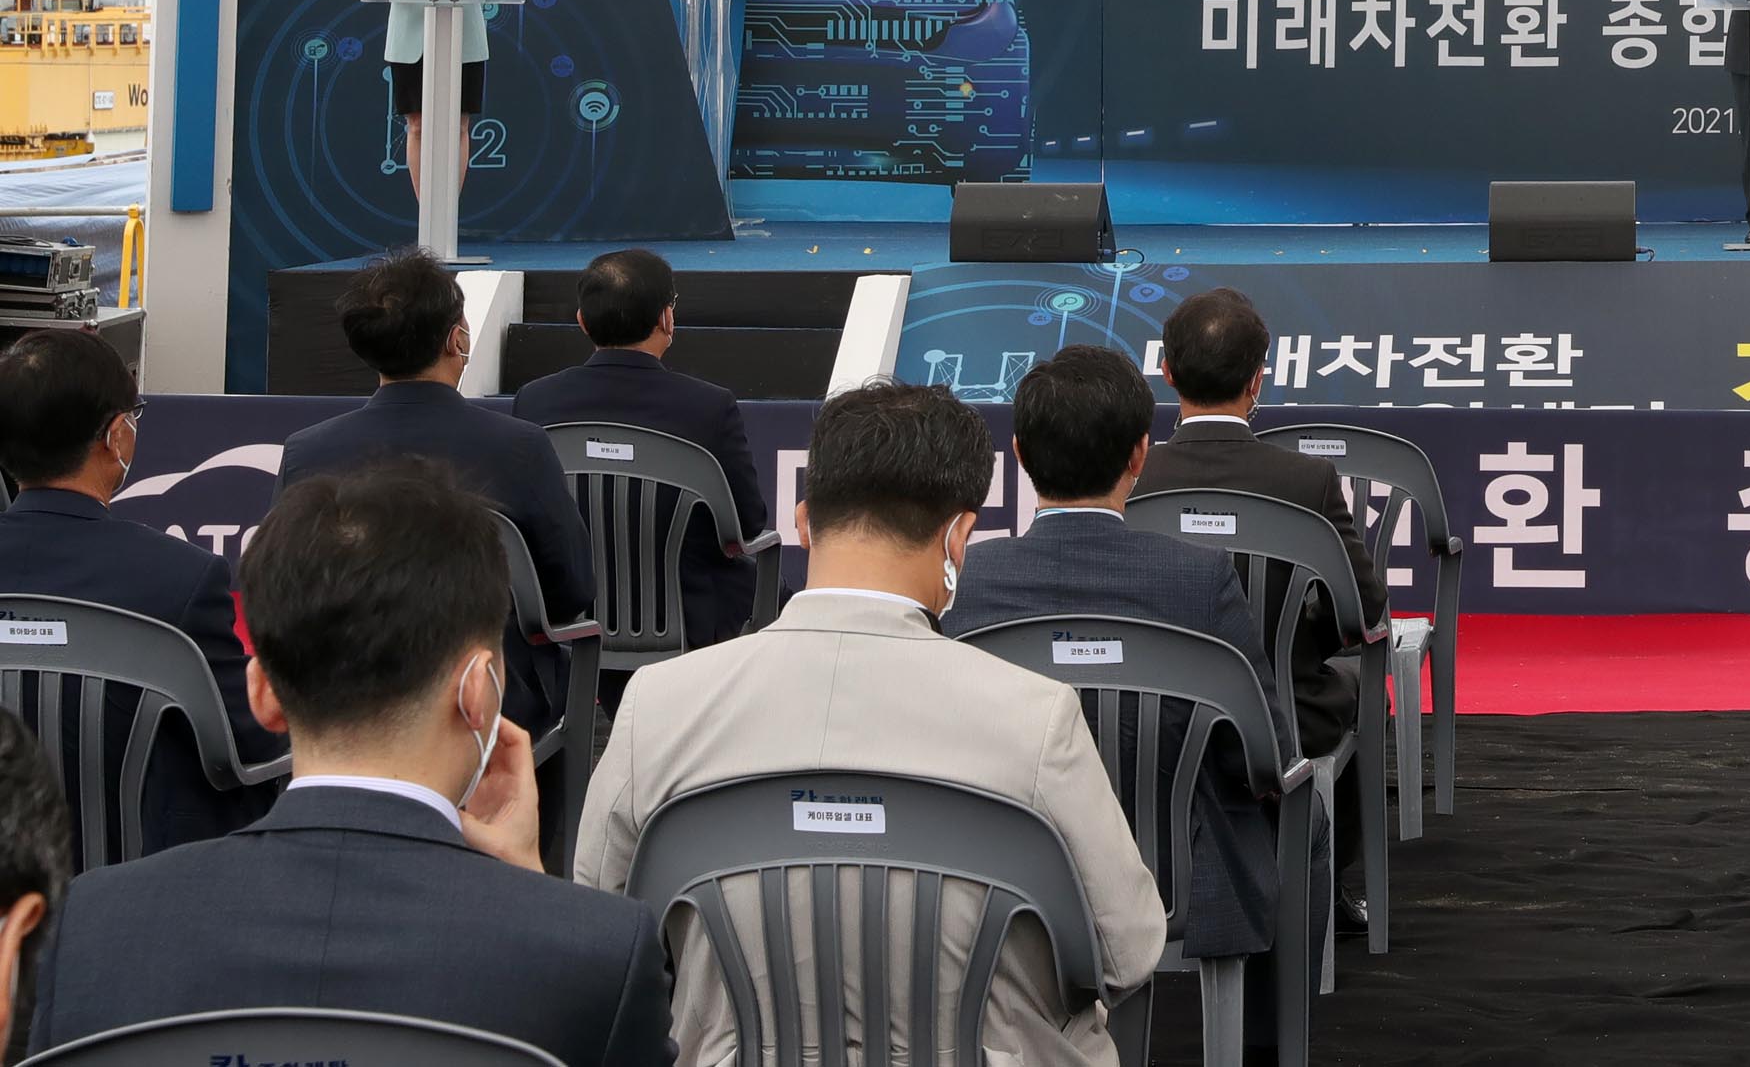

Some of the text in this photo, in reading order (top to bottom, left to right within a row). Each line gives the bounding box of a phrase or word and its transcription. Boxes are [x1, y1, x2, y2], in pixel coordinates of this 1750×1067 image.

[1093, 647, 1106, 655] 대표
[807, 811, 873, 822] 케이퓨얼셀 대표
